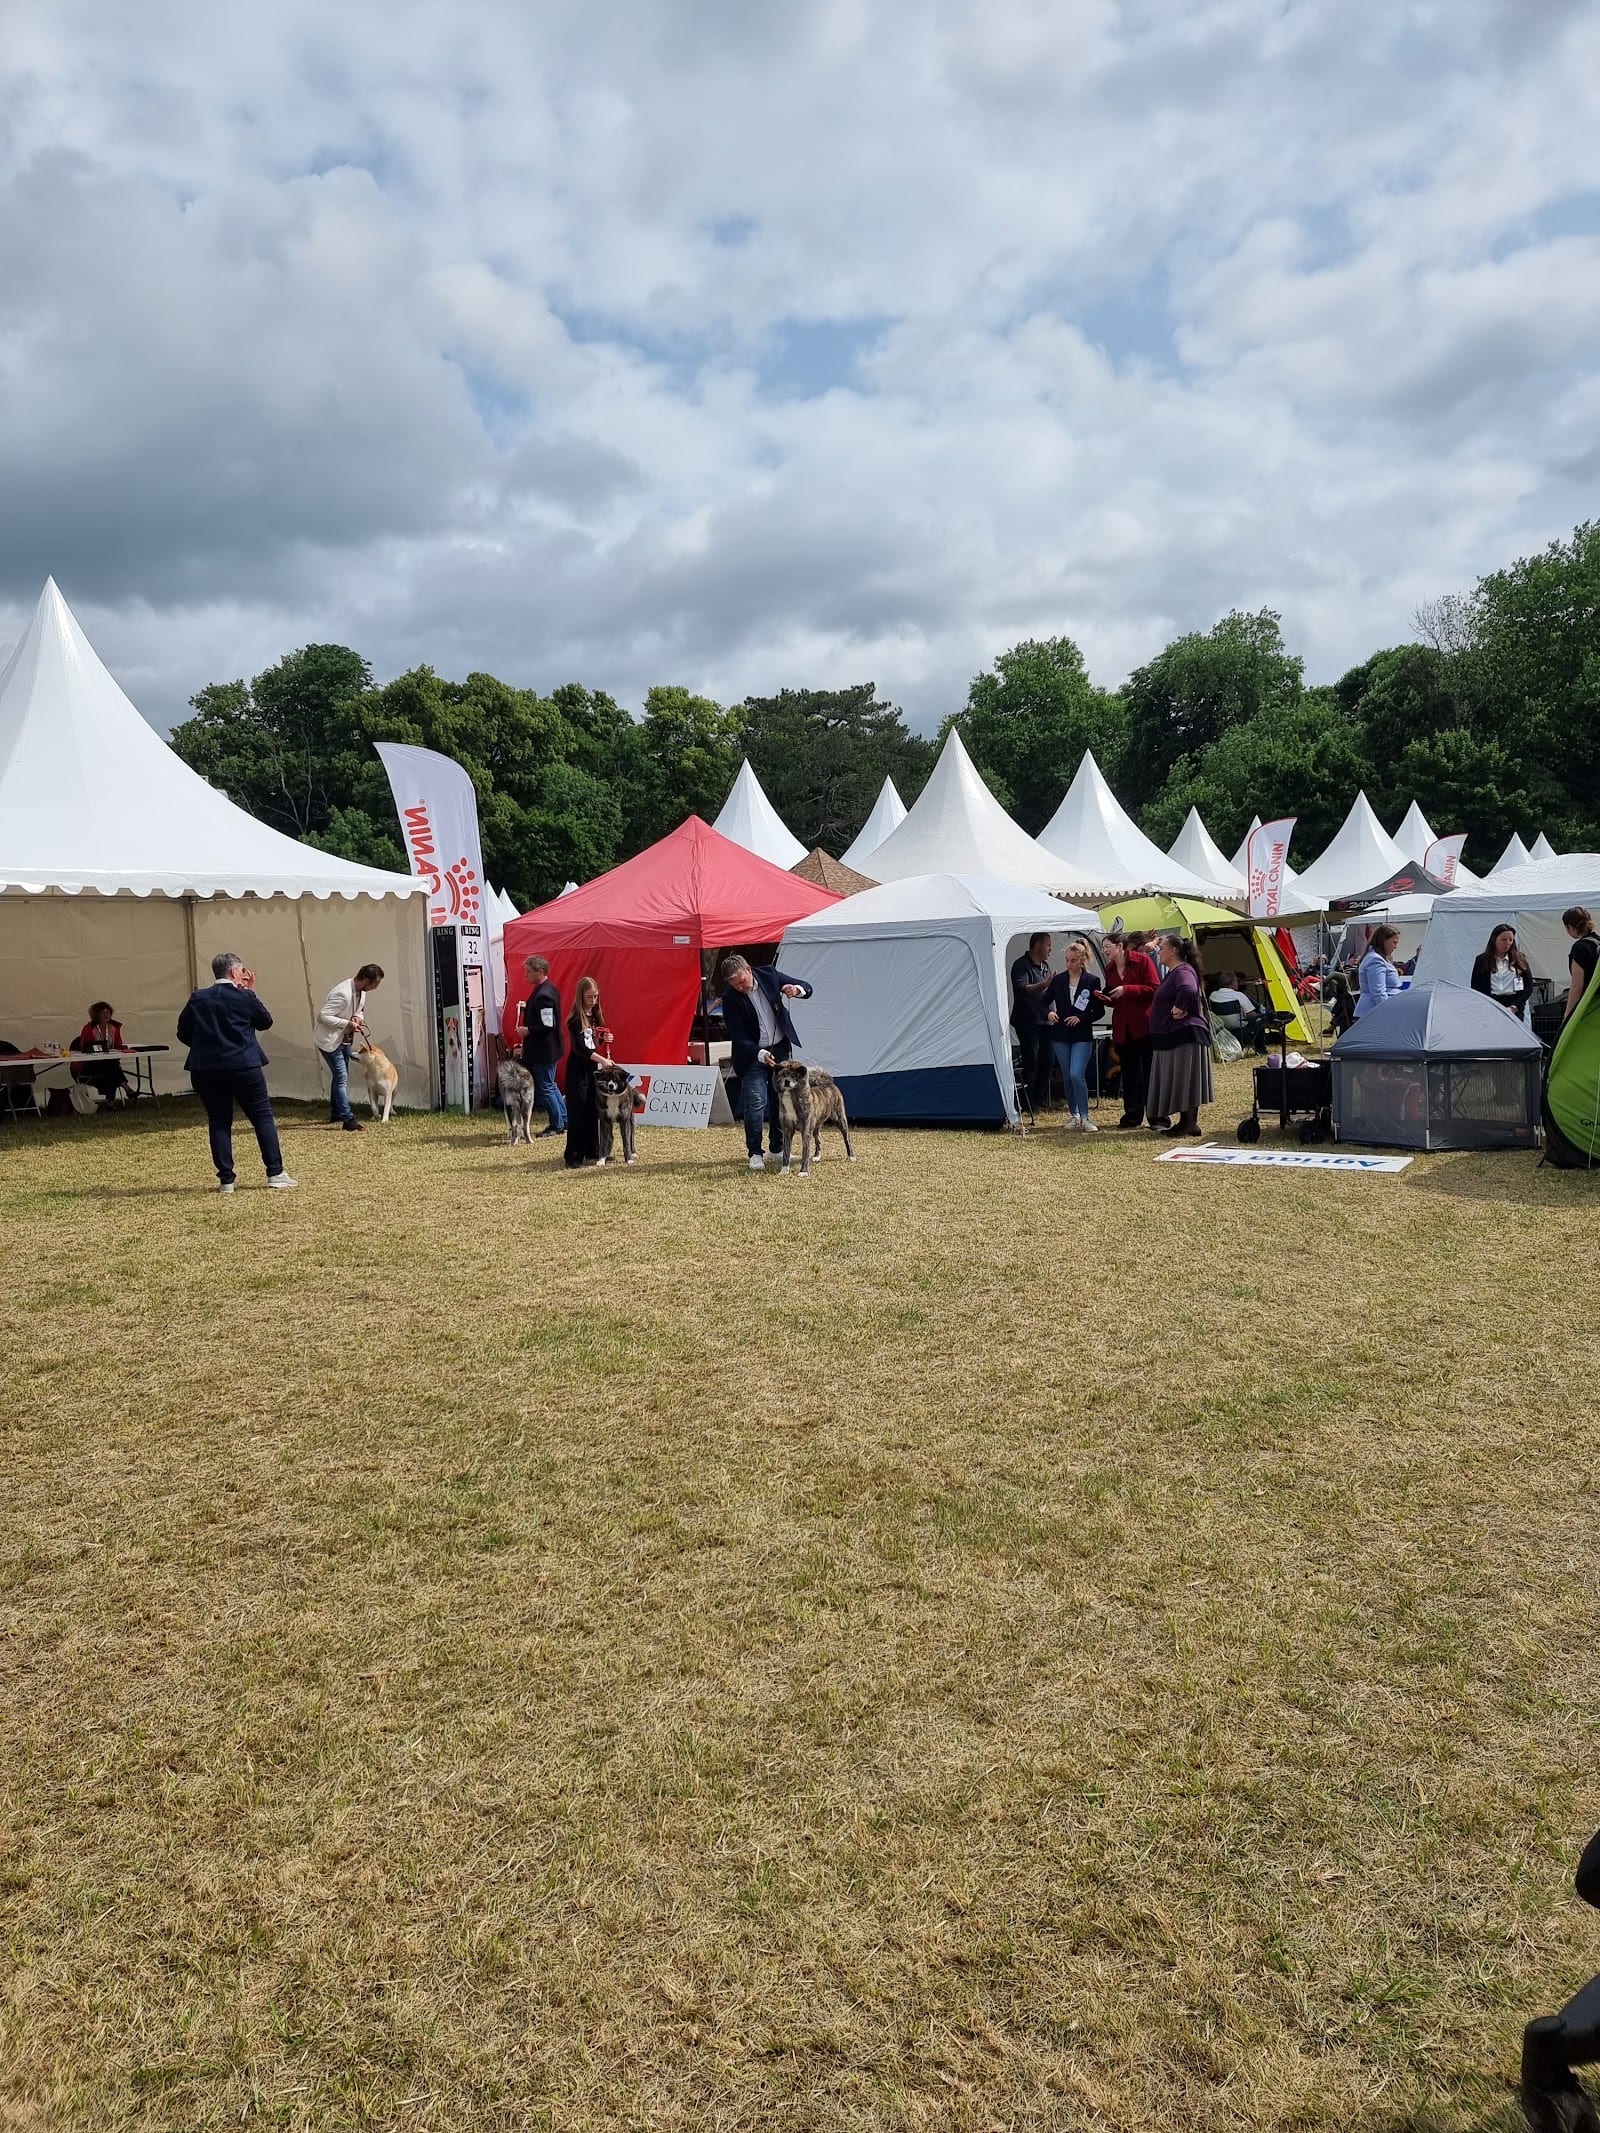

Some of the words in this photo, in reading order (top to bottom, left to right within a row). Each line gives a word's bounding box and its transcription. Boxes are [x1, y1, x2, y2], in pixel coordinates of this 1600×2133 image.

[1268, 843, 1284, 883] CANIN
[1444, 855, 1457, 881] ANIN
[1266, 885, 1278, 917] OYAL
[1348, 900, 1379, 909] 24M
[436, 926, 454, 936] RING
[464, 926, 480, 935] RING
[468, 941, 478, 954] 32
[652, 1079, 712, 1096] CENTRALE
[649, 1098, 709, 1115] CANINE
